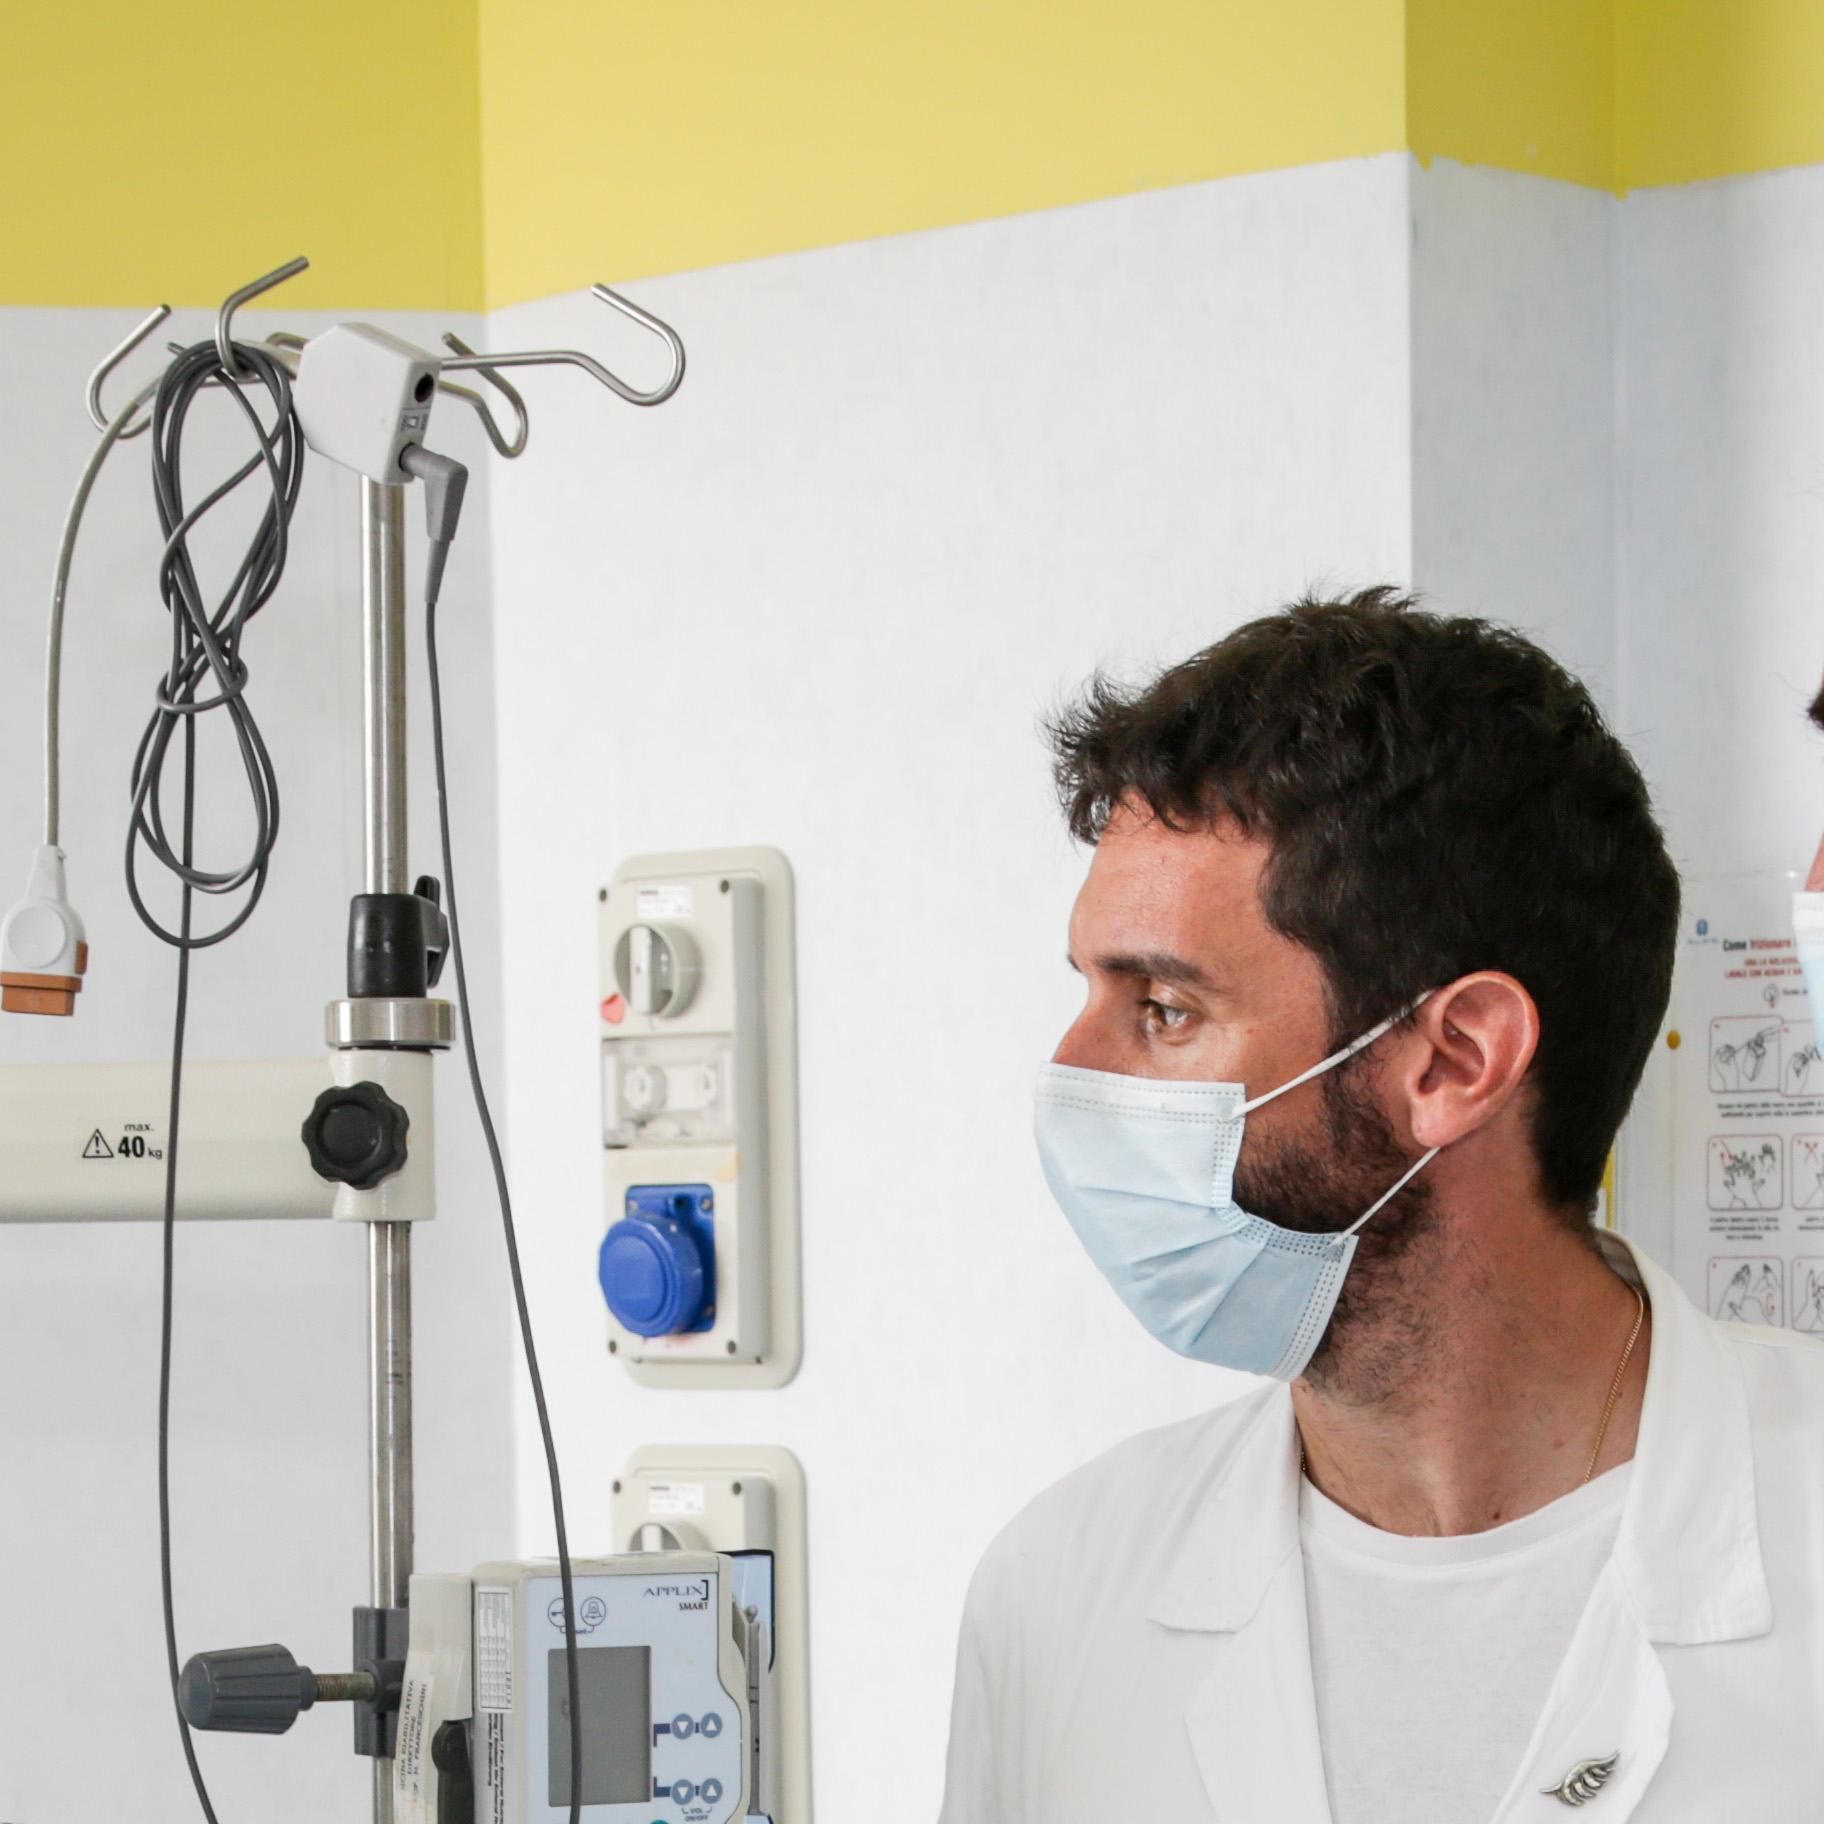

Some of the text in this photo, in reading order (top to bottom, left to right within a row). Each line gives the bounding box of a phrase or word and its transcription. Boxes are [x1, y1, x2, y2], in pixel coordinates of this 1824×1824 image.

[123, 1123, 155, 1132] max.
[118, 1135, 163, 1160] 40 kg
[679, 1601, 708, 1611] SMART
